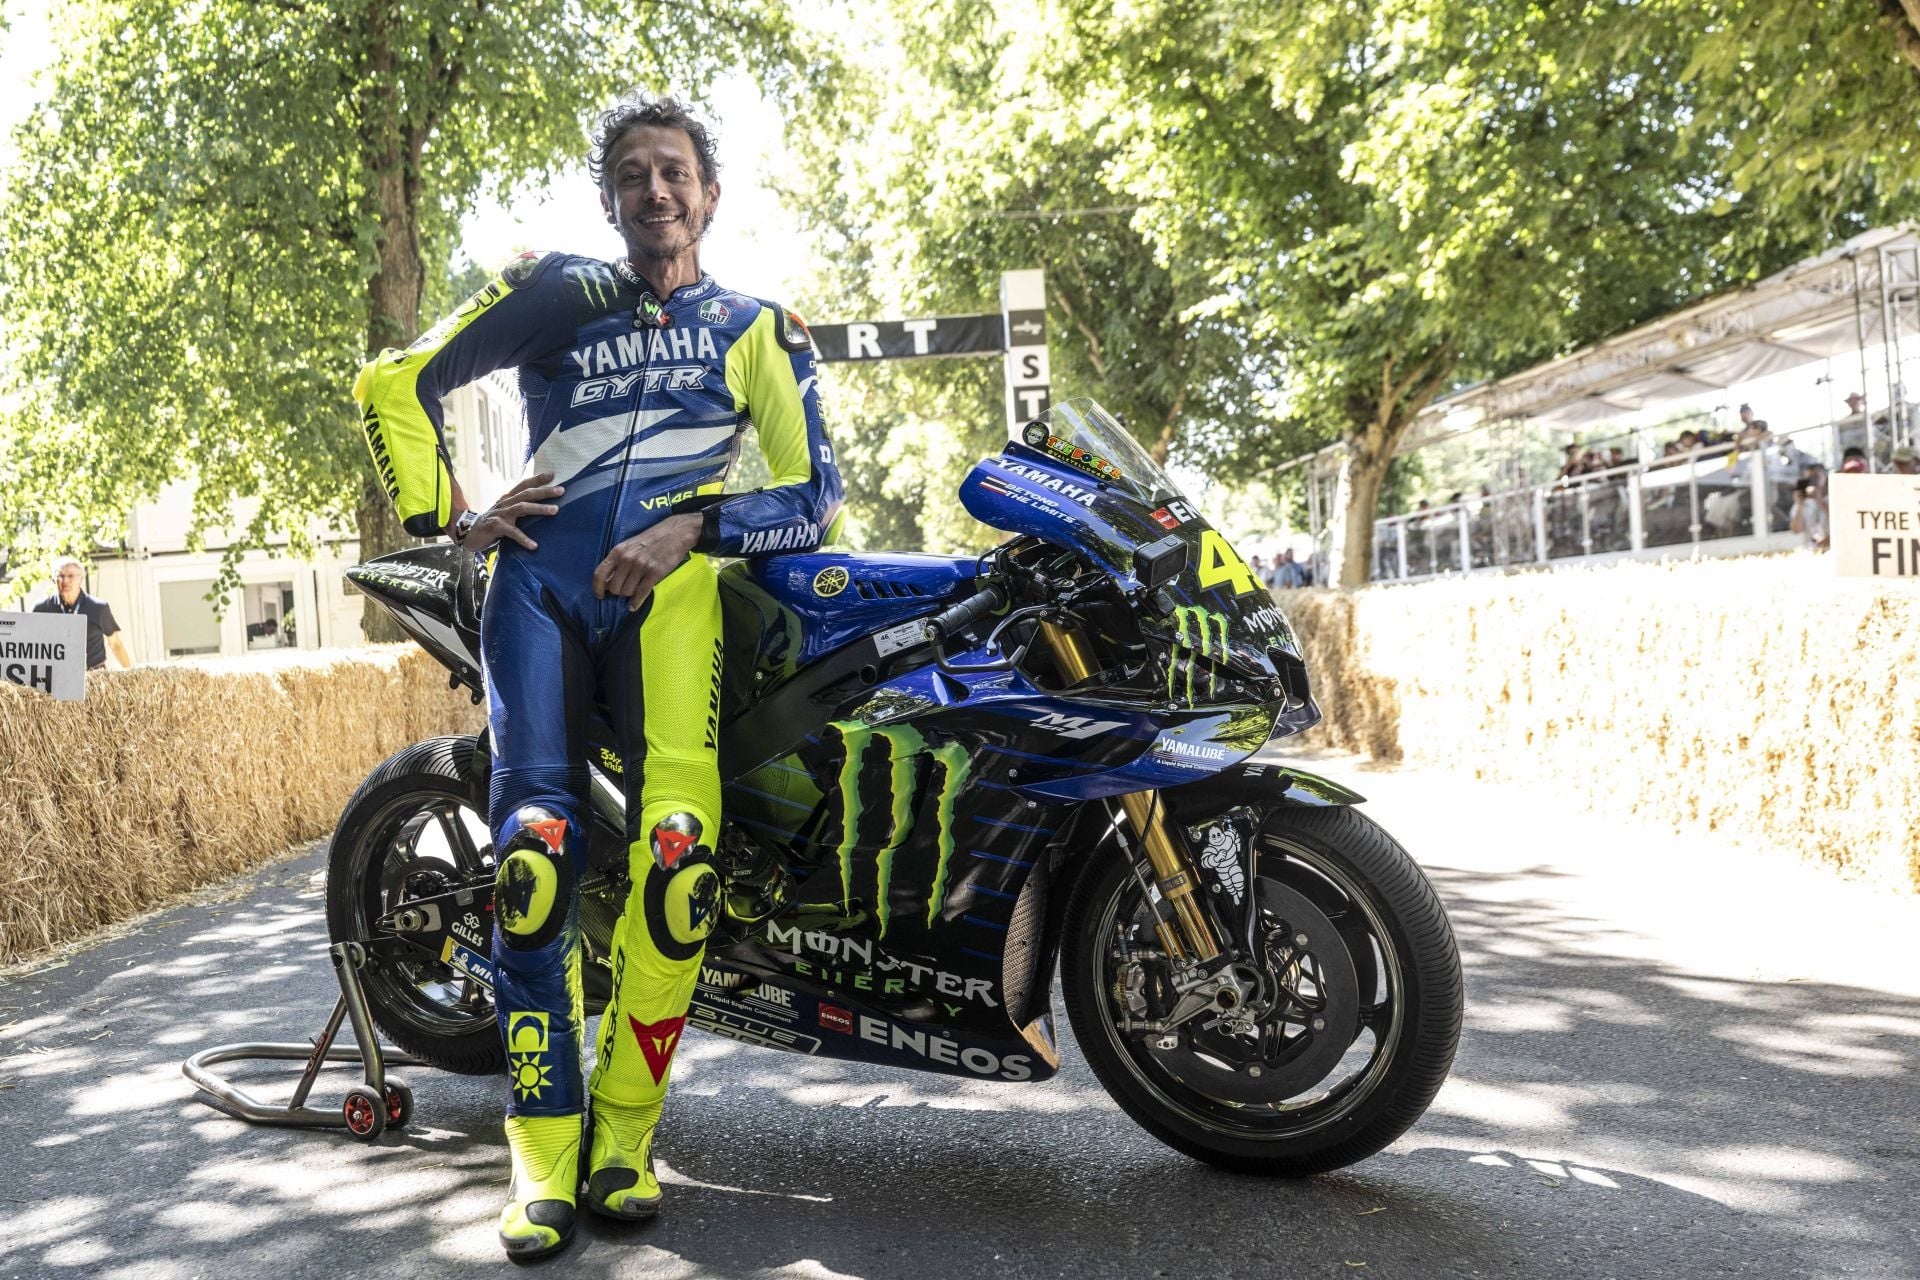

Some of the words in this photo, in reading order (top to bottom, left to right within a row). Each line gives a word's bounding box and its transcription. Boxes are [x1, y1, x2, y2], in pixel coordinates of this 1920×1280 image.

[570, 327, 719, 379] YAMAHA
[570, 365, 707, 409] GYTR
[363, 402, 401, 502] YAMAHA
[1046, 435, 1076, 456] THE
[1071, 447, 1122, 480] DOCTOR
[998, 459, 1098, 507] YAMAHA
[1005, 483, 1059, 508] BEYOND
[1004, 490, 1031, 504] THE
[1030, 501, 1076, 524] LIMITS
[1857, 510, 1909, 531] TYRE
[740, 523, 818, 553] YAMAHA
[357, 570, 425, 594] ENERGY
[704, 637, 724, 753] YAMAHA
[1161, 737, 1226, 760] YAMALUBE
[451, 921, 484, 947] GILLES
[795, 960, 963, 1017] ENERY
[694, 1006, 798, 1044] BLUE
[710, 993, 730, 1004] Liquid
[731, 1001, 753, 1012] Engine
[754, 1007, 792, 1024] Component
[821, 1012, 850, 1026] ENEOS
[859, 1015, 1032, 1081] ENEOS
